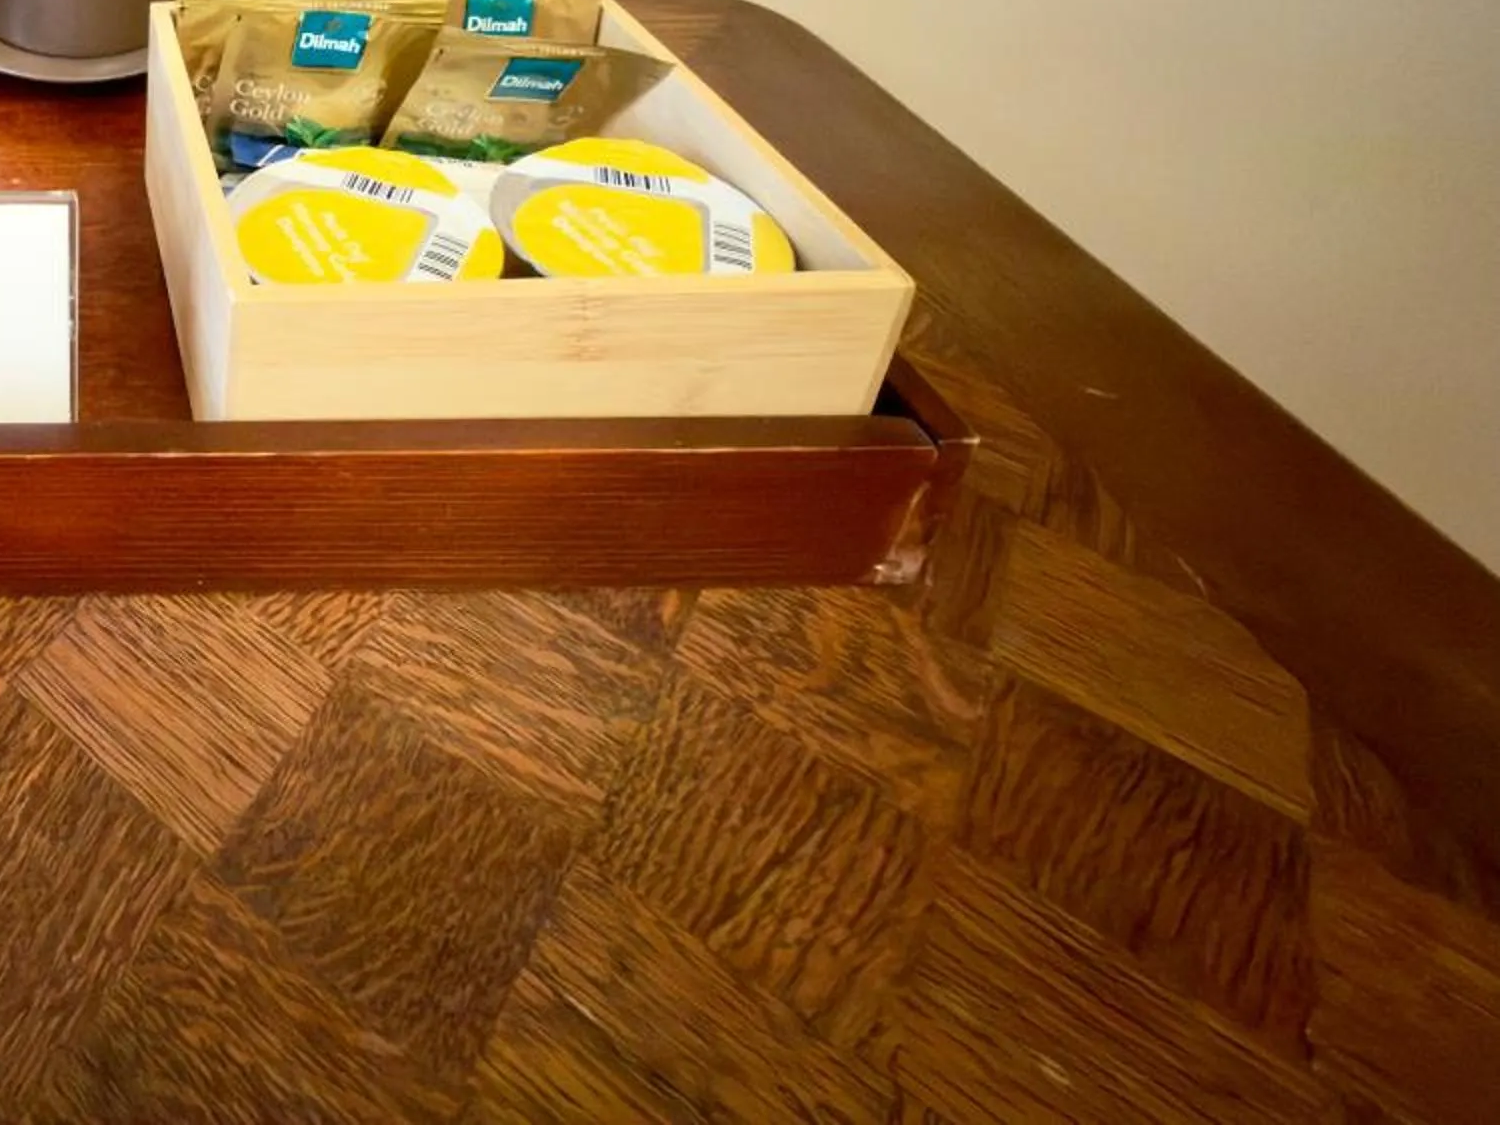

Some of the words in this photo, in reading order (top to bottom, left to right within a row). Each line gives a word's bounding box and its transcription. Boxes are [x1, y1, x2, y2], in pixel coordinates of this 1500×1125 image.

[467, 15, 528, 33] Dilmah
[300, 31, 361, 54] Dilmah
[236, 79, 311, 106] Ceylon
[500, 75, 563, 91] Dilmah
[230, 99, 285, 121] Gold
